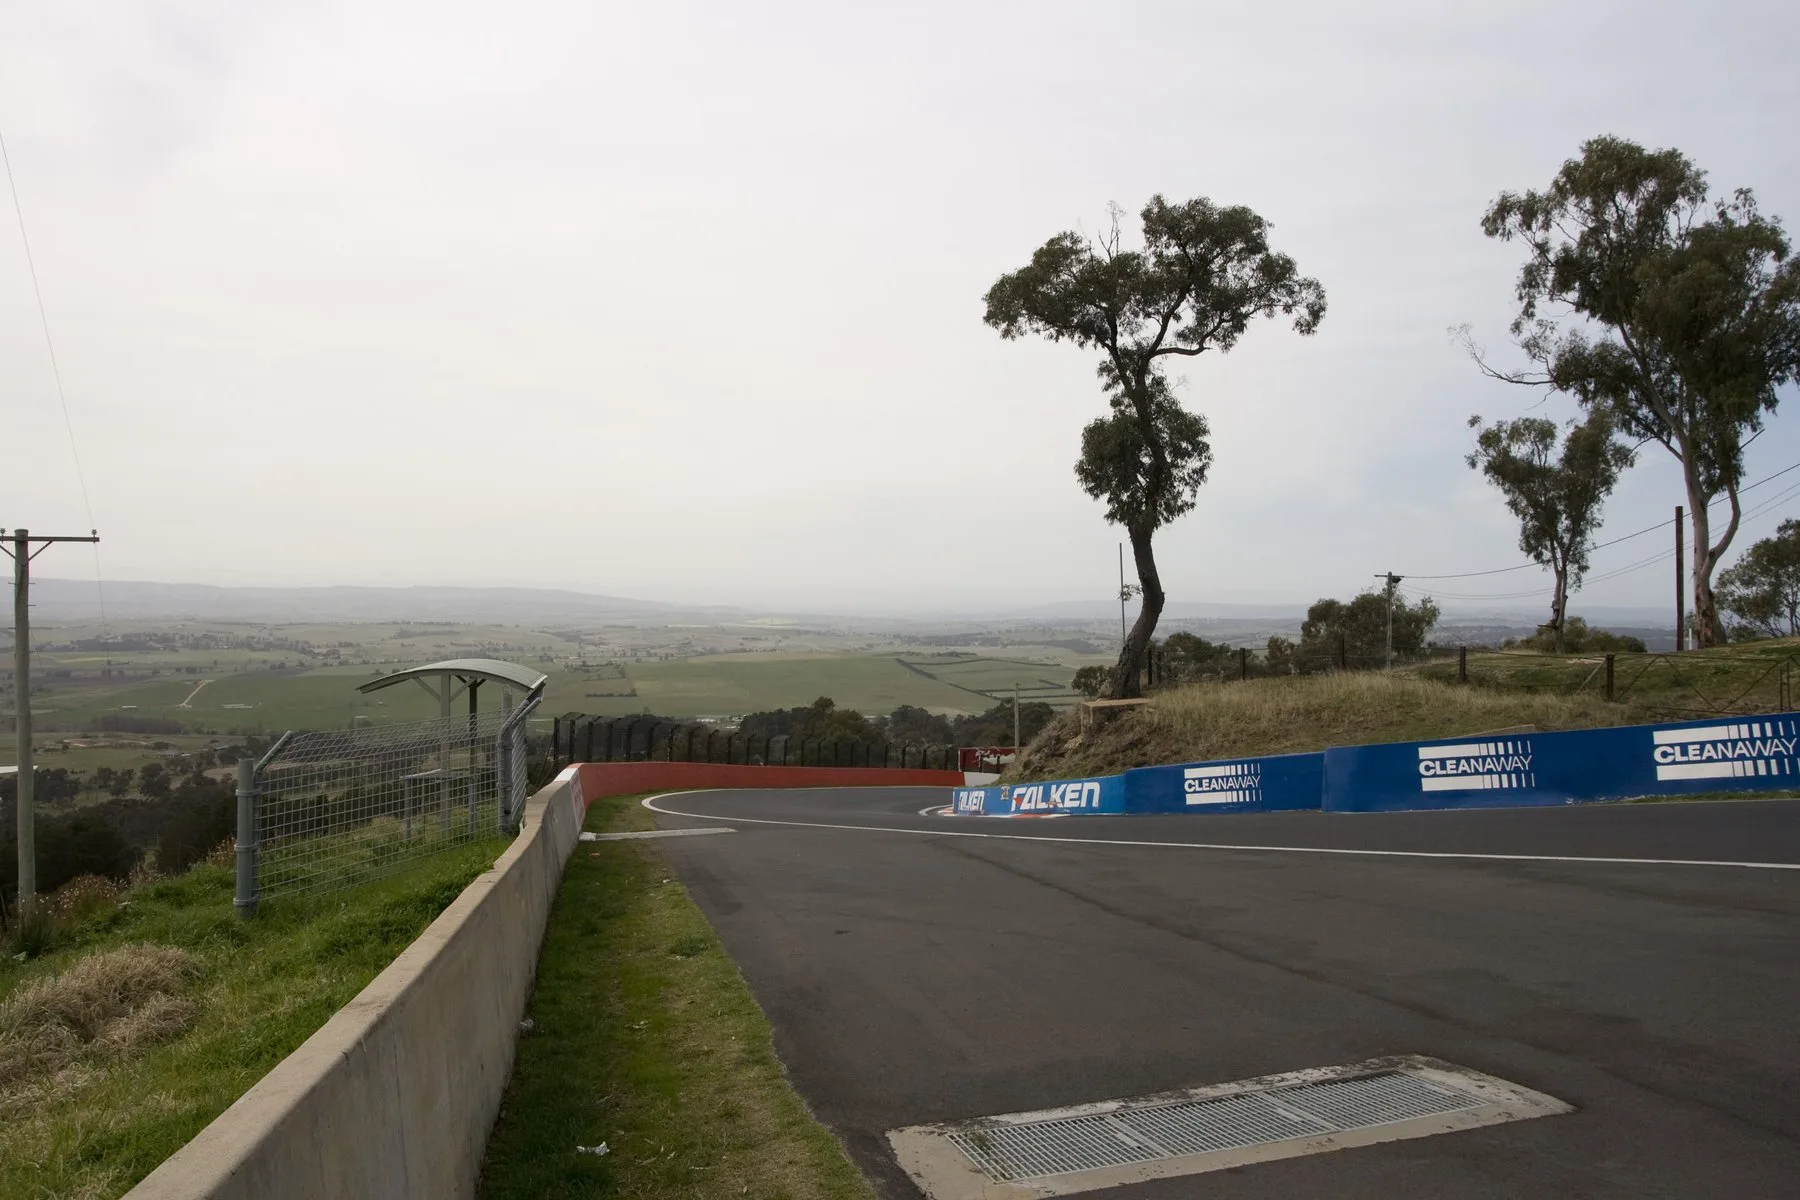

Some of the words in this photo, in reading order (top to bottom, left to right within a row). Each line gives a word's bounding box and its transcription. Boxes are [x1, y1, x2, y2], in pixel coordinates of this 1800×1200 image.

[1653, 737, 1798, 764] CLEANAWAY
[1418, 755, 1532, 776] CLEANAWAY
[1184, 775, 1261, 793] CLEANAWAY
[1010, 782, 1101, 812] FALKEN
